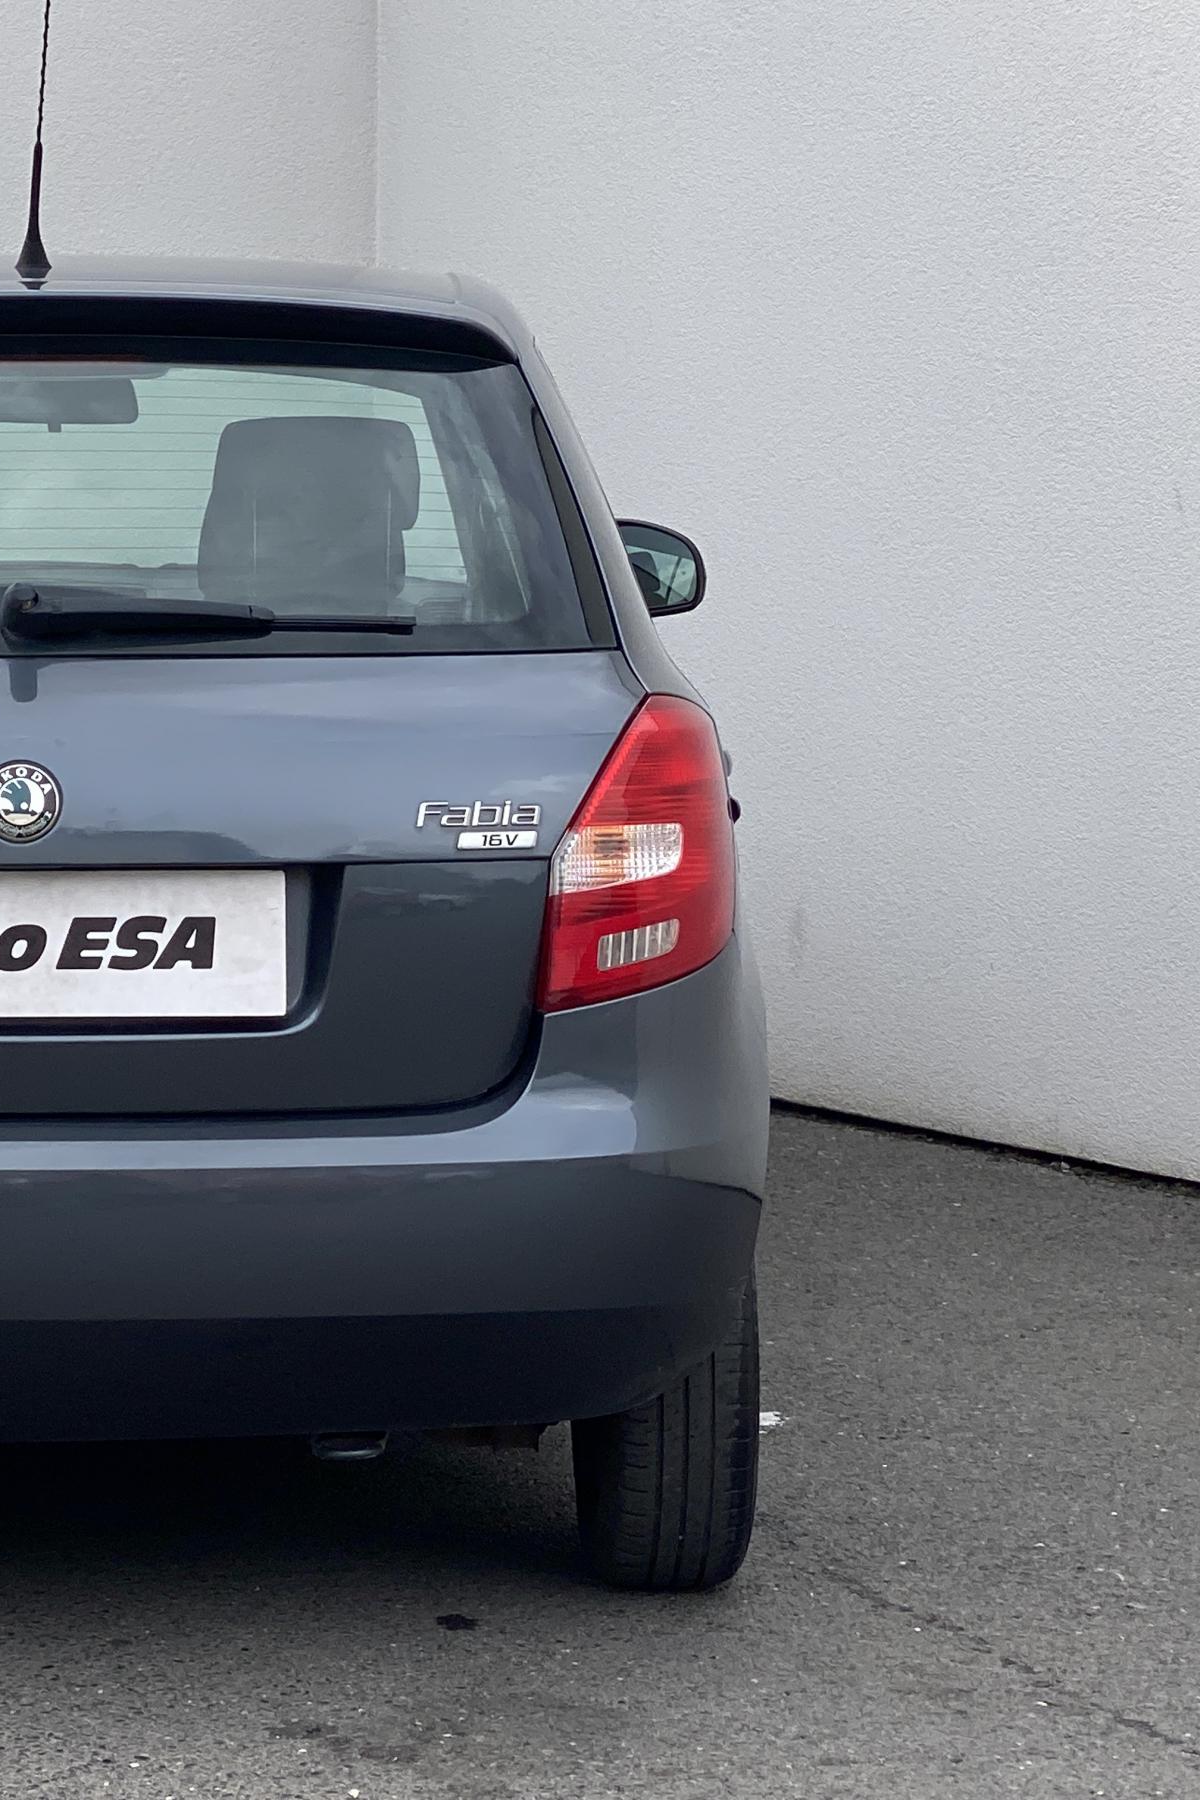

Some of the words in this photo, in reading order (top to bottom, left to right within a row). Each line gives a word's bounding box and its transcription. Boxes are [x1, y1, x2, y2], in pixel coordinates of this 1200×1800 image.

[416, 800, 541, 828] Fabia
[482, 834, 519, 847] 16V
[55, 915, 217, 971] ESA
